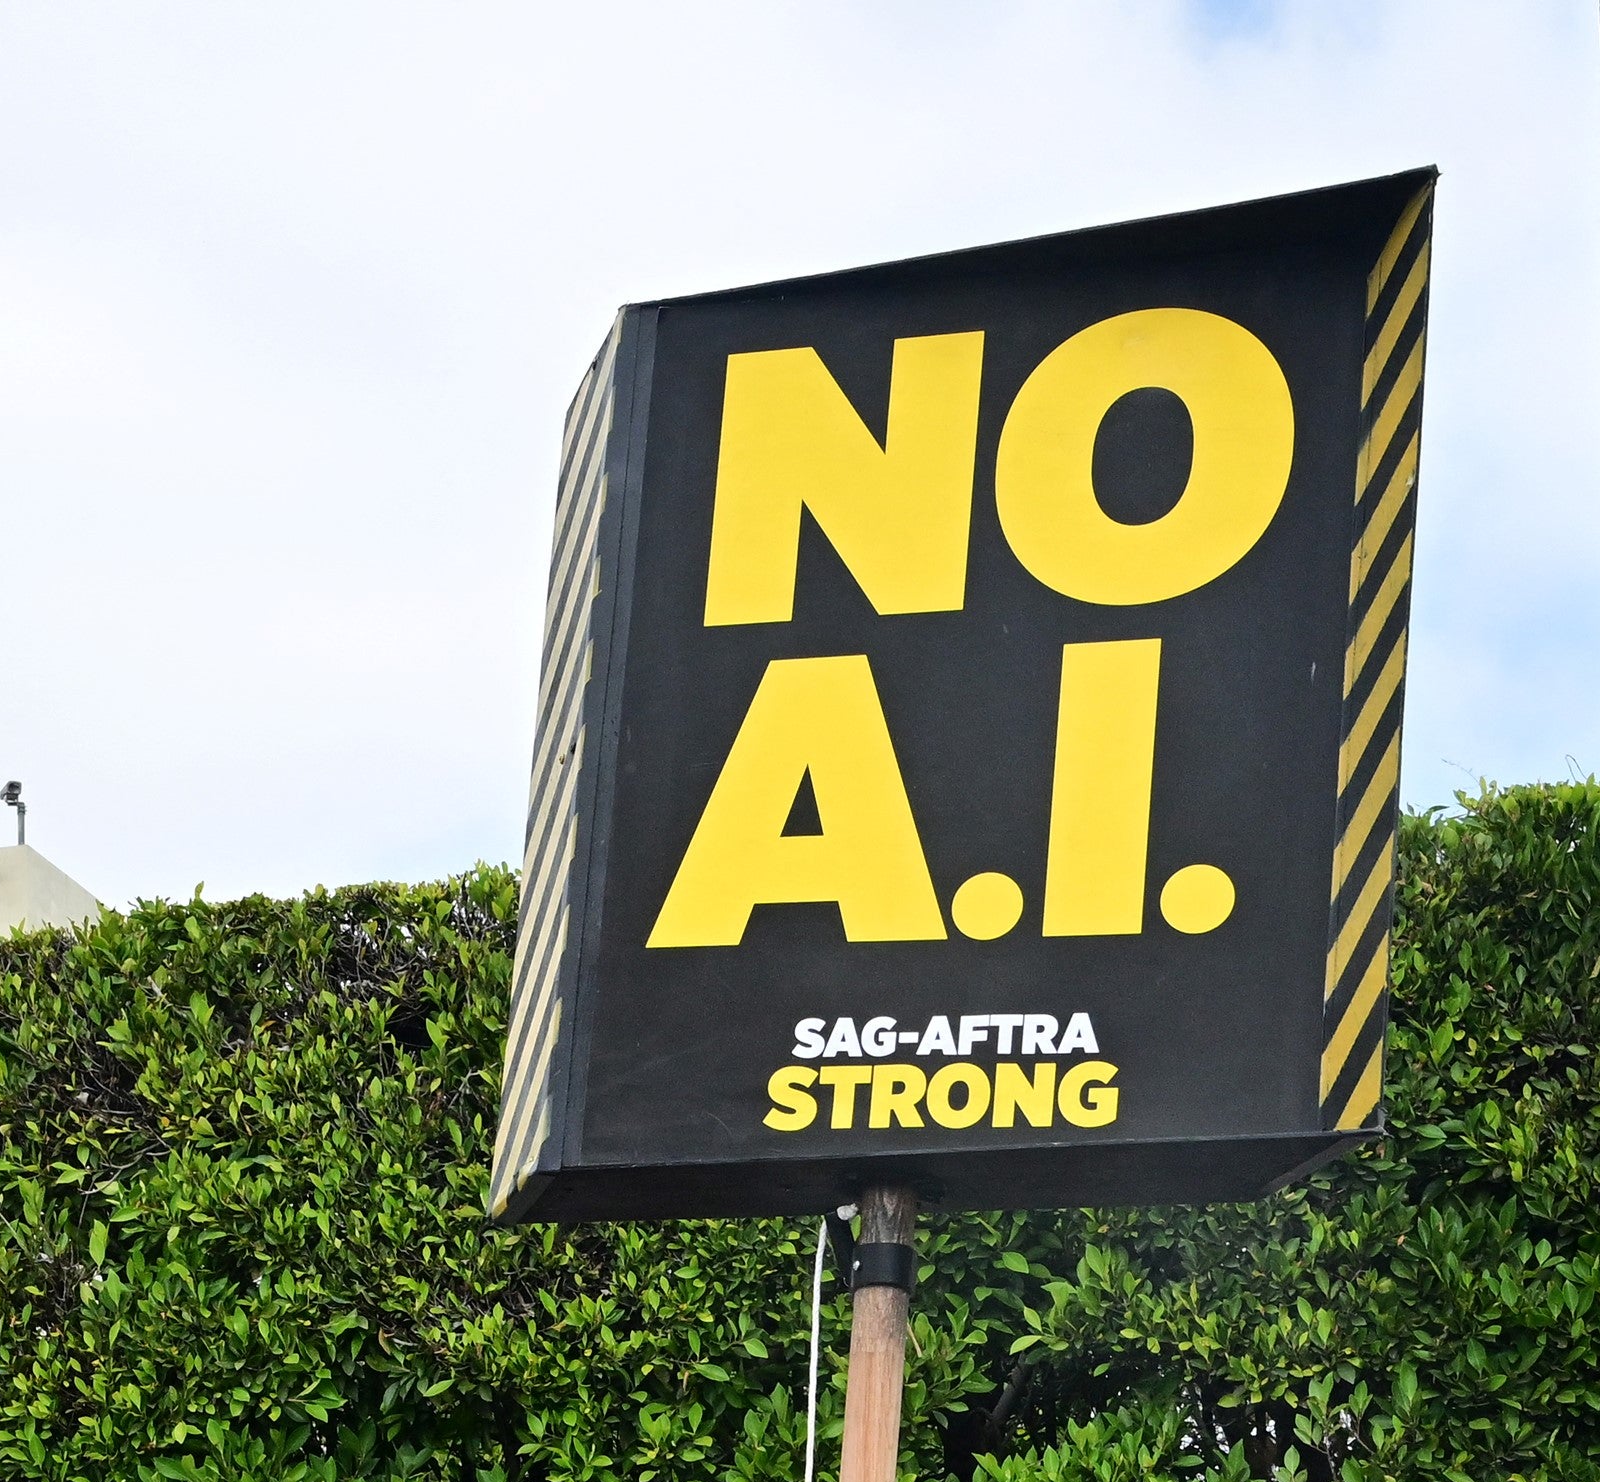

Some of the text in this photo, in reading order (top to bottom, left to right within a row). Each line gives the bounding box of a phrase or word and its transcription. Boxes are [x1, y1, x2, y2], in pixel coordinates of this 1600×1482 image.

[703, 307, 1296, 627] NO
[645, 638, 1236, 949] A.I.
[762, 1062, 1120, 1131] STRONG
[792, 1012, 1100, 1060] SAG-AFTRA
